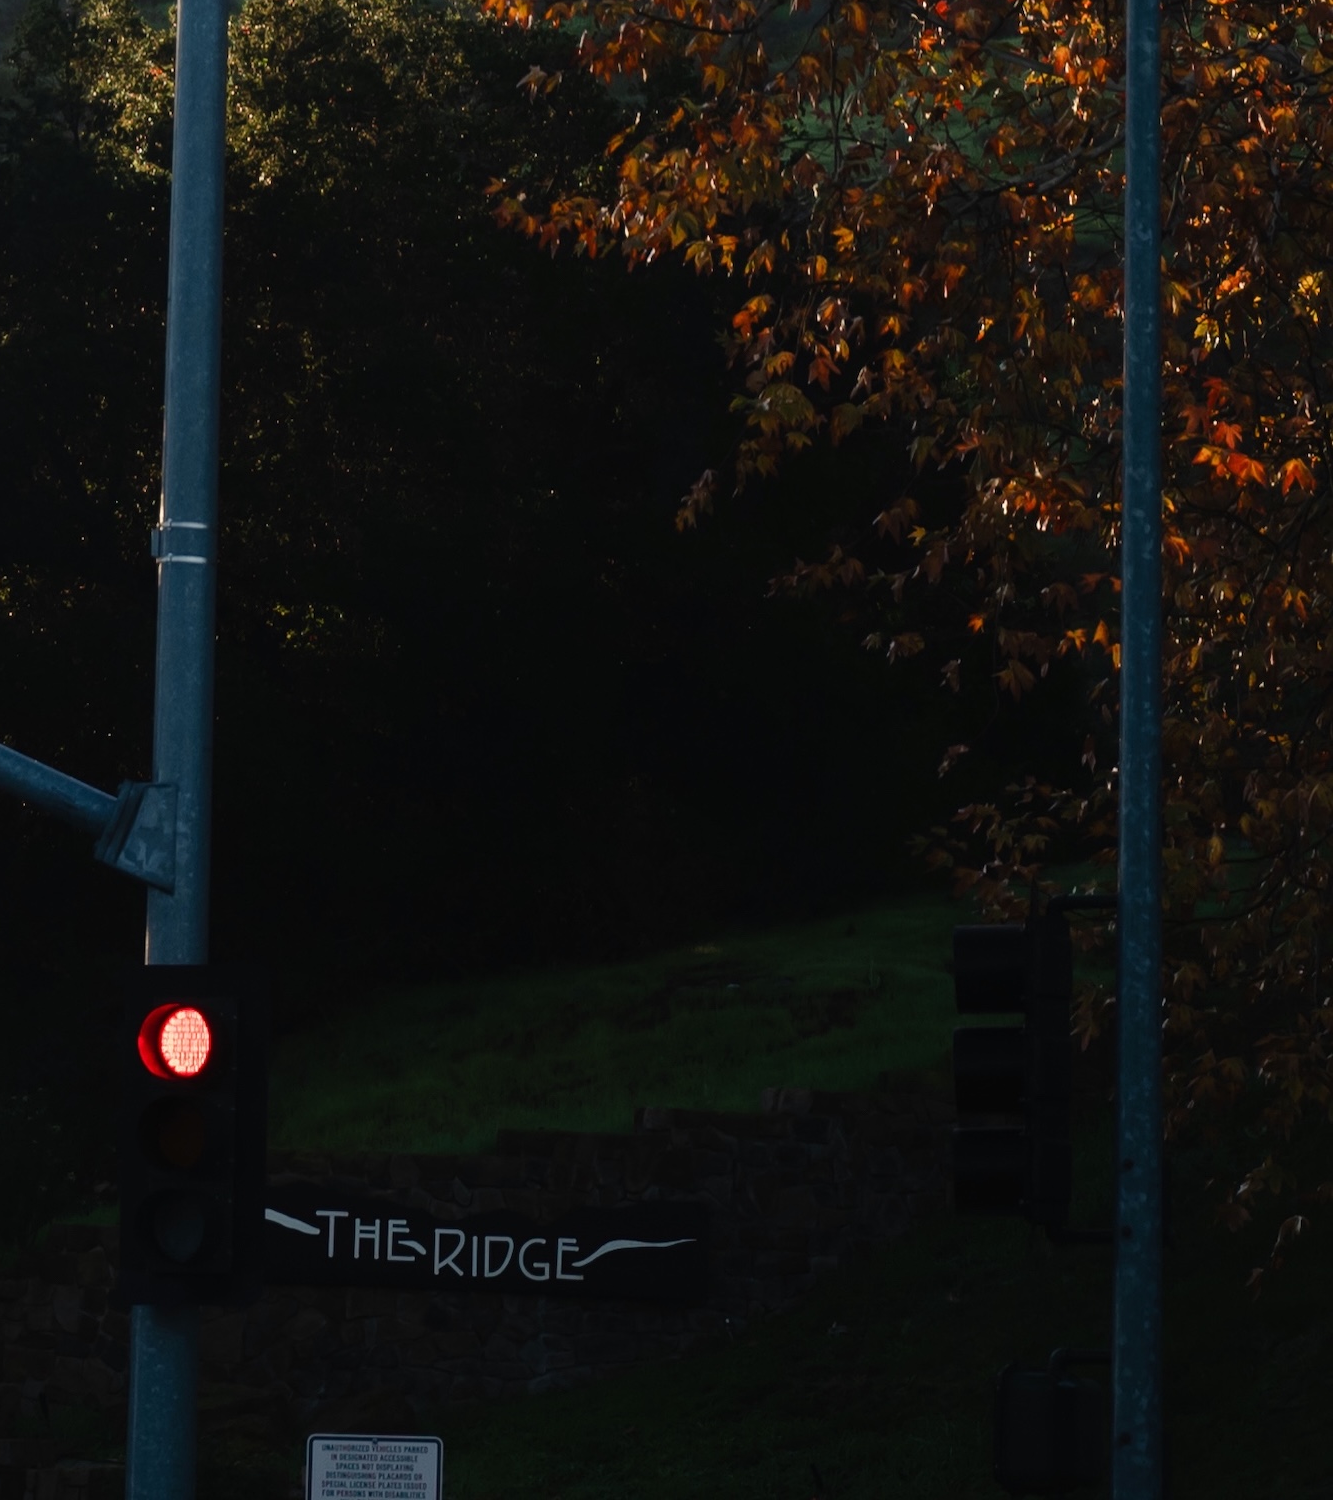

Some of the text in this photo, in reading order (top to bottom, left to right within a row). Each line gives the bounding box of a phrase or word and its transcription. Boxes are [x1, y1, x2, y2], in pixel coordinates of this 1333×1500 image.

[315, 1209, 585, 1282] THE RIDGE
[321, 1444, 429, 1454] UNAUTHORIZED VEHICLES PARKED
[331, 1453, 418, 1463] IN DESIGNATED ACCESSIBLE
[335, 1462, 414, 1472] SPACES NOT DISPLAYING
[326, 1471, 423, 1481] DISTINGUISHING PLACARDS OR
[321, 1480, 428, 1491] SPECIAL LICENSE PLATES ISSUED
[321, 1489, 426, 1499] FOR PERSONS WITH DISABILITIES
